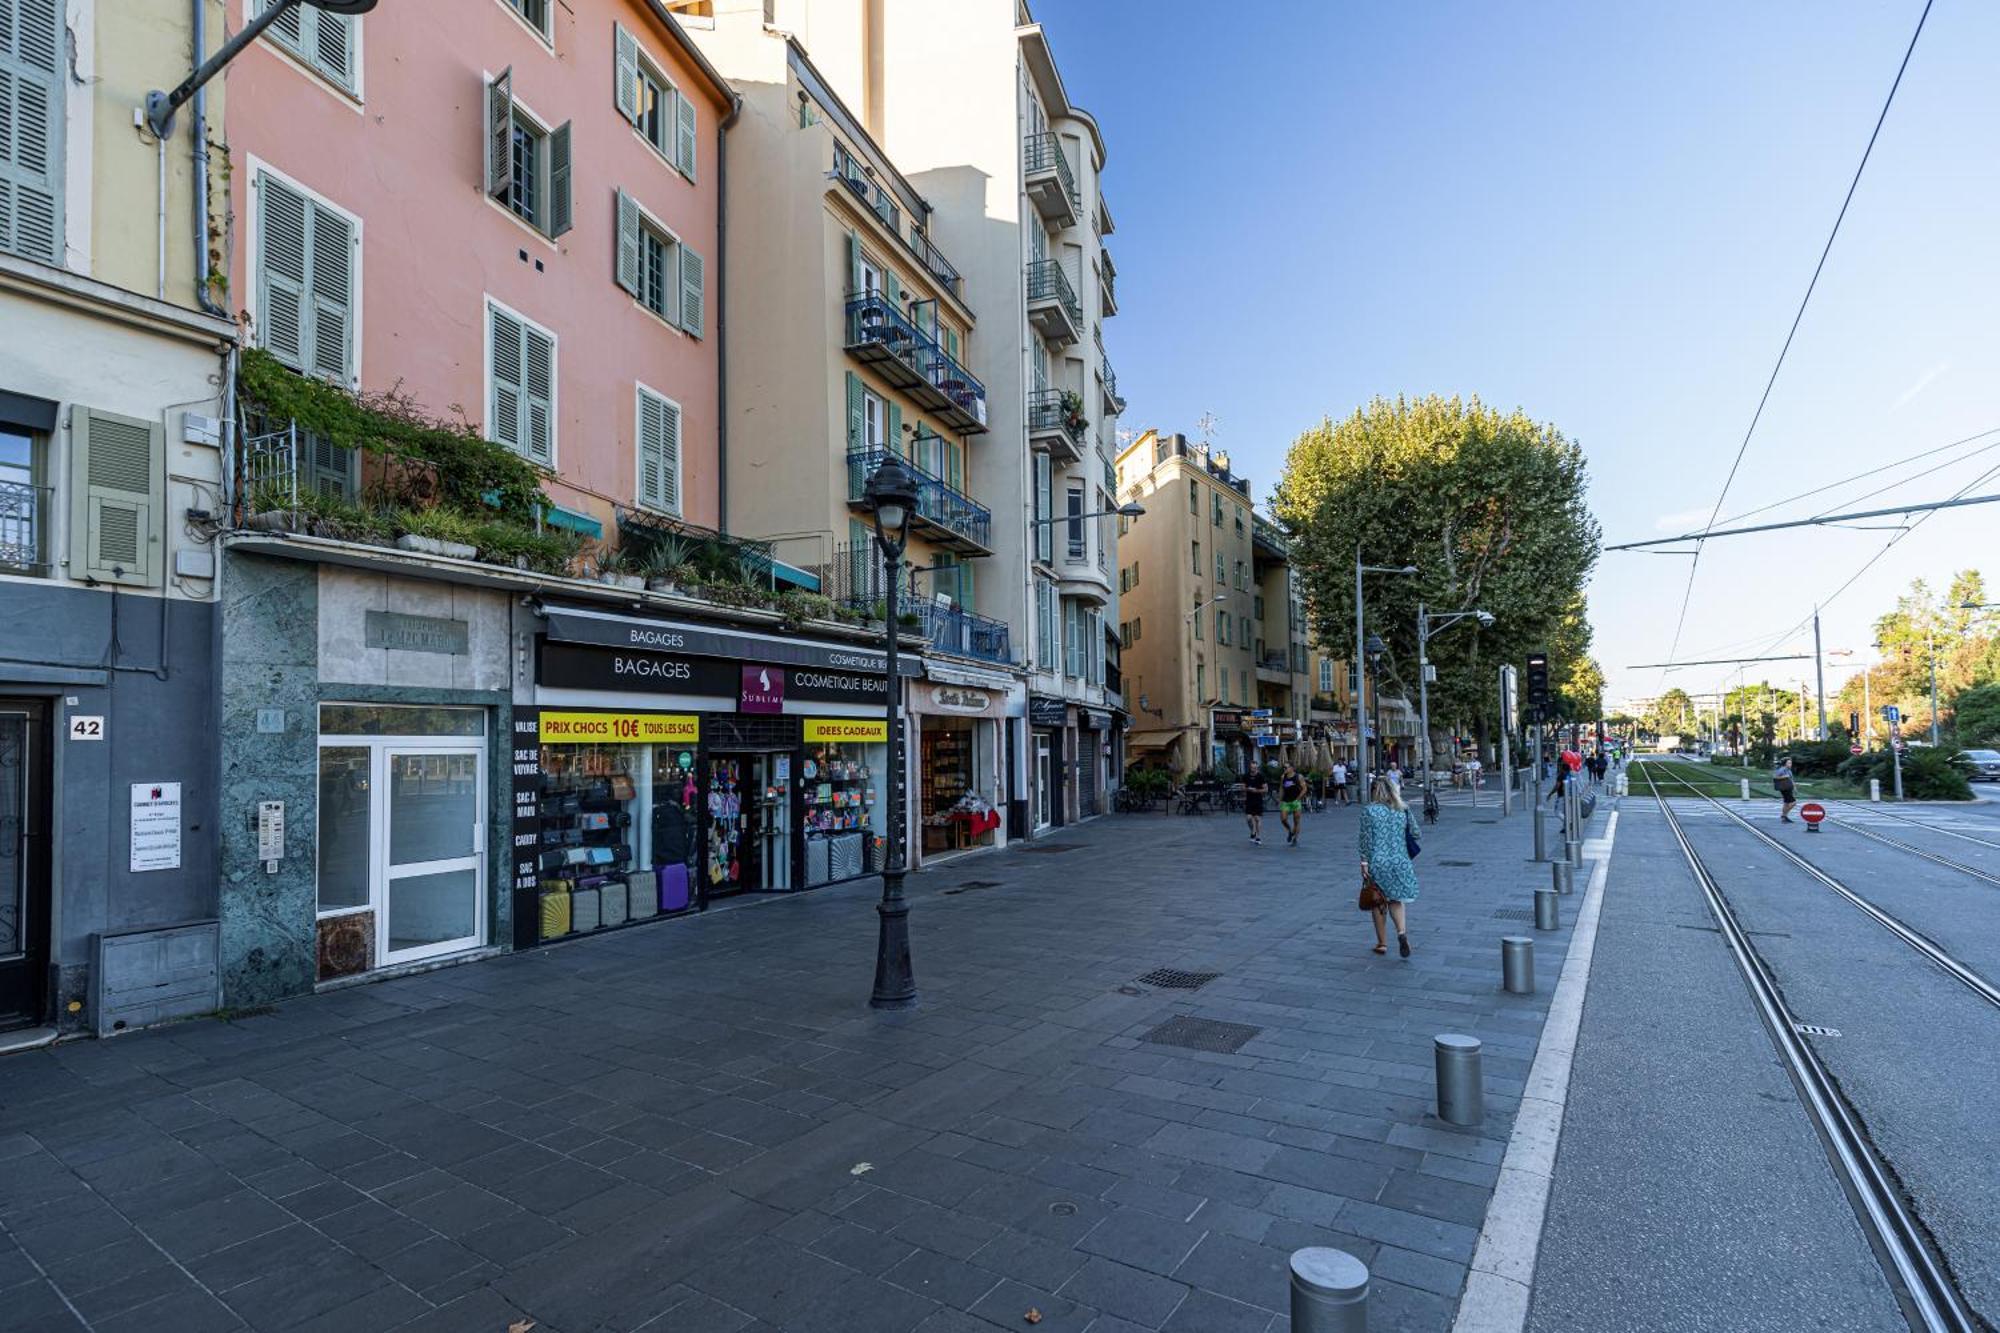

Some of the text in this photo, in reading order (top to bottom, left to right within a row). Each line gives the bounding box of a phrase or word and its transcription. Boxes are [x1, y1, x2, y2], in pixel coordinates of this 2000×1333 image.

[630, 629, 684, 647] BAGAGES
[829, 653, 877, 668] COSMETIQUE
[614, 657, 690, 679] BAGAGES
[795, 672, 889, 692] COSMETIQUE BEAUT
[73, 720, 99, 735] 42
[514, 721, 538, 733] VALISE
[545, 719, 694, 737] PRIX CHOCS 10€ TOUS LES SACS
[816, 726, 882, 737] IDEES CADEAUX
[514, 749, 528, 761] SAC
[516, 792, 530, 803] SAC
[516, 805, 536, 817] MAIN
[519, 862, 533, 874] SAC
